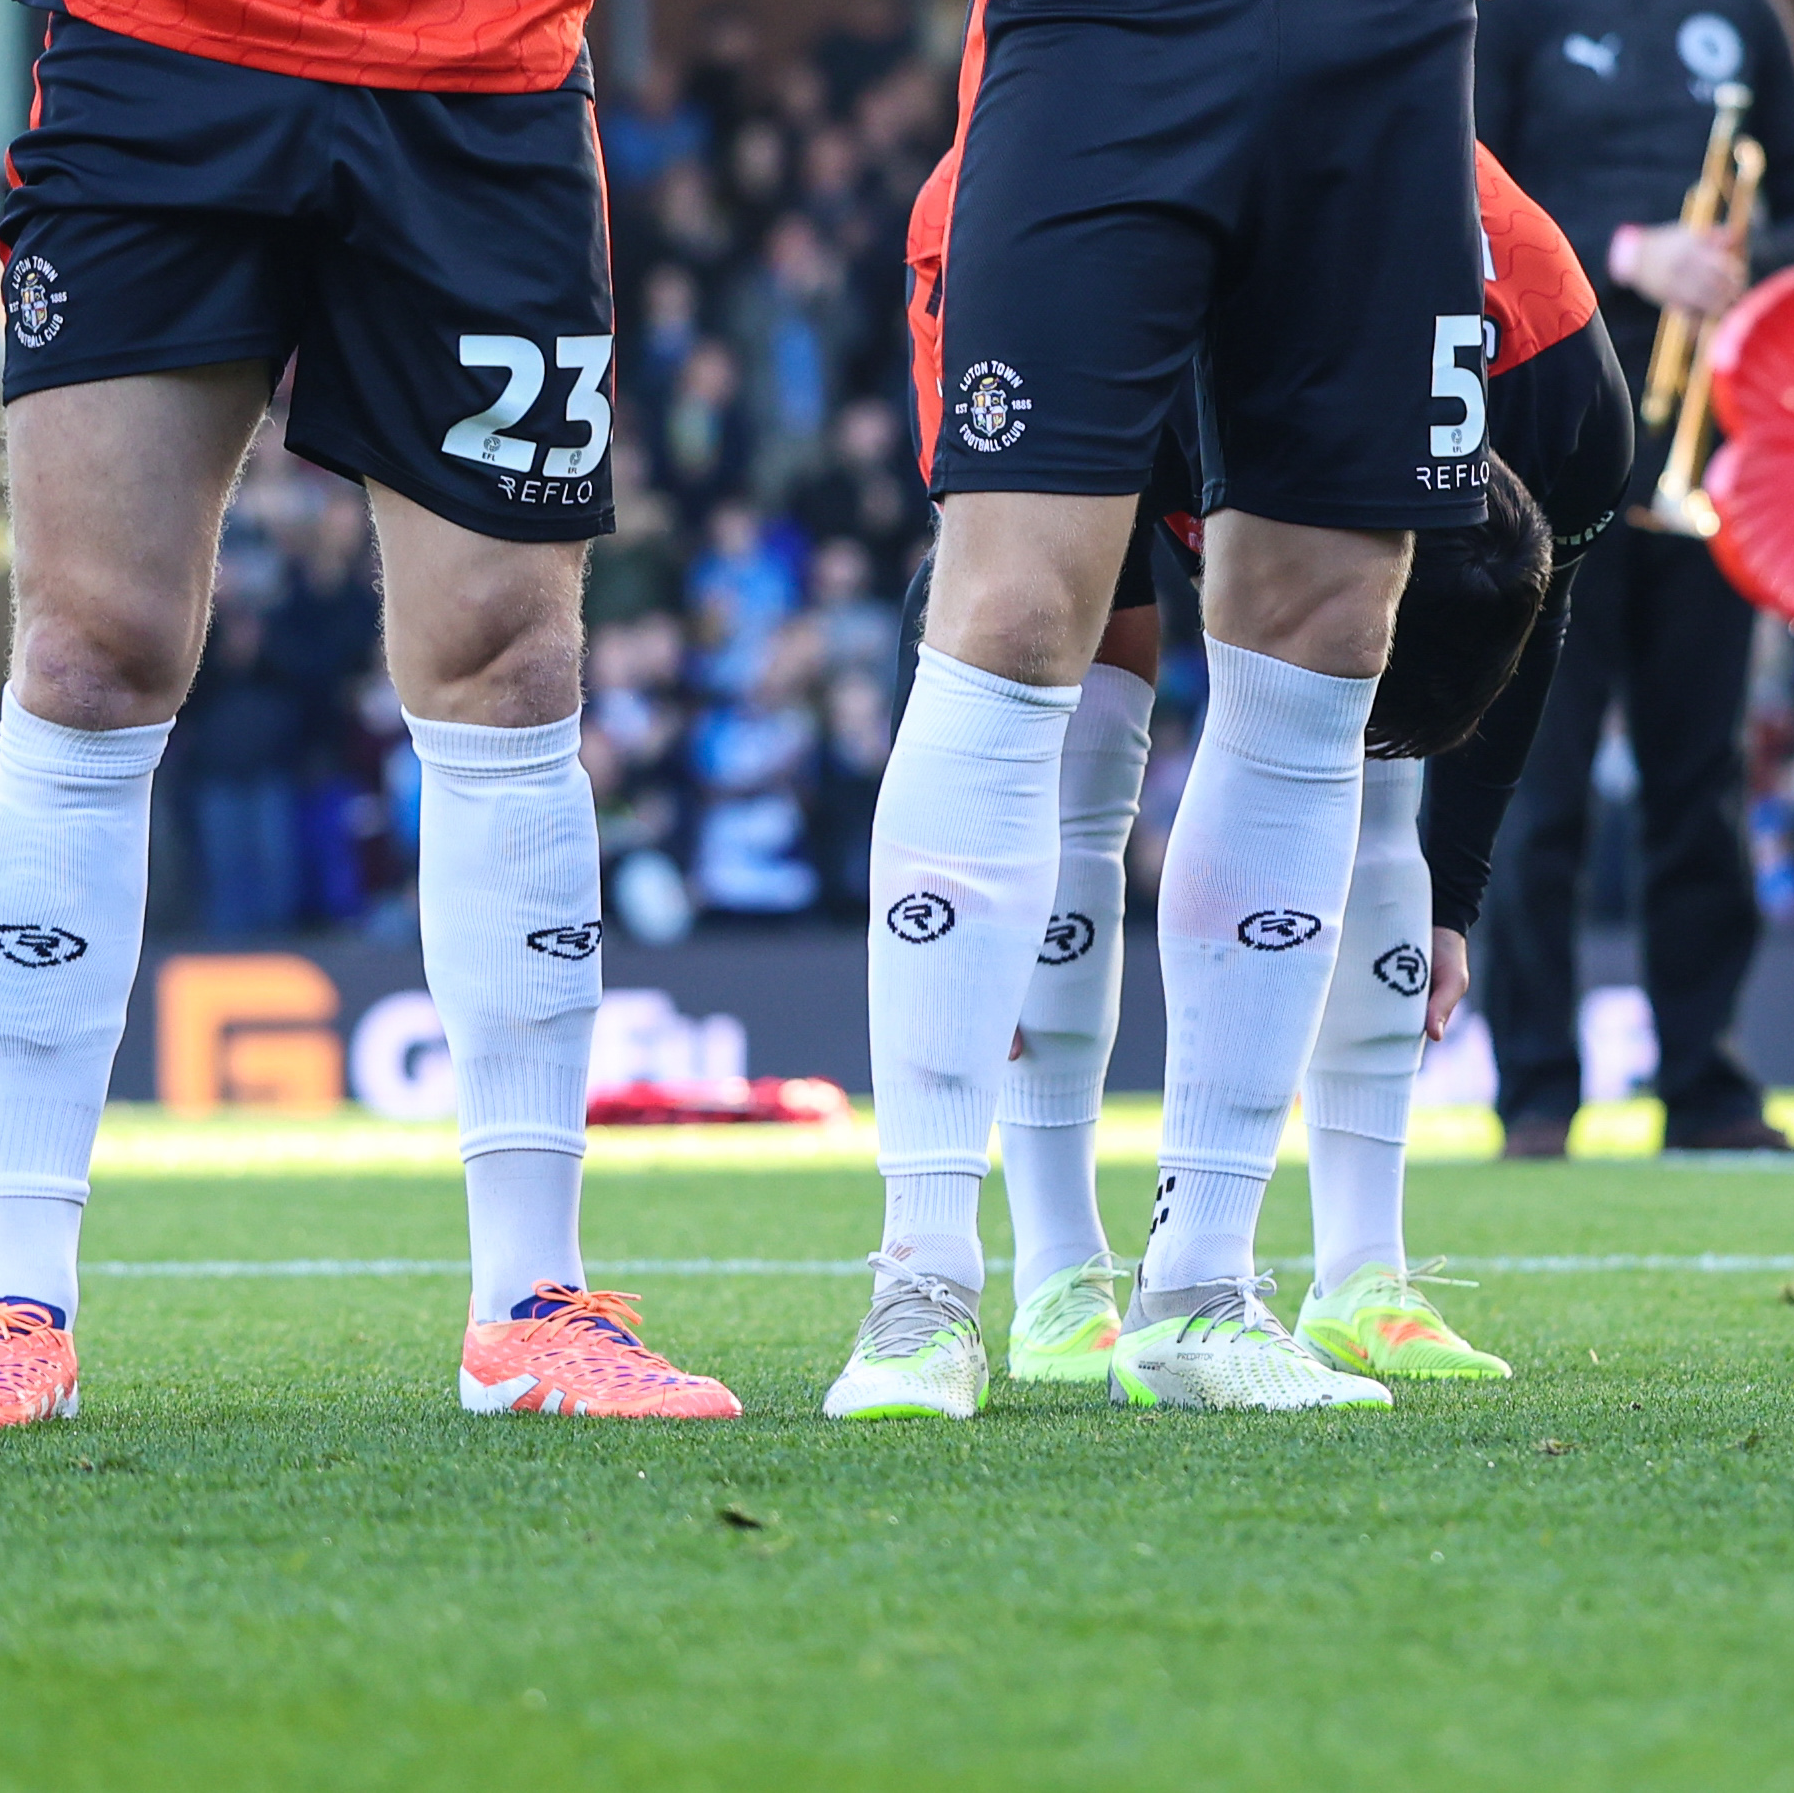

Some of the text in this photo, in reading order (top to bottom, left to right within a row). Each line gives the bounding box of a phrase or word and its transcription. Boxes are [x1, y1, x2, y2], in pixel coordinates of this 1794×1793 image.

[959, 359, 1024, 392] LUTON TOWN
[1429, 314, 1486, 458] 5
[440, 334, 615, 479] 23
[955, 402, 968, 415] EST
[959, 420, 1026, 453] FOOTBALL CLUB
[481, 451, 496, 462] EFL
[567, 466, 578, 475] EFL
[497, 474, 593, 505] REFLO
[1415, 460, 1490, 491] REFLO
